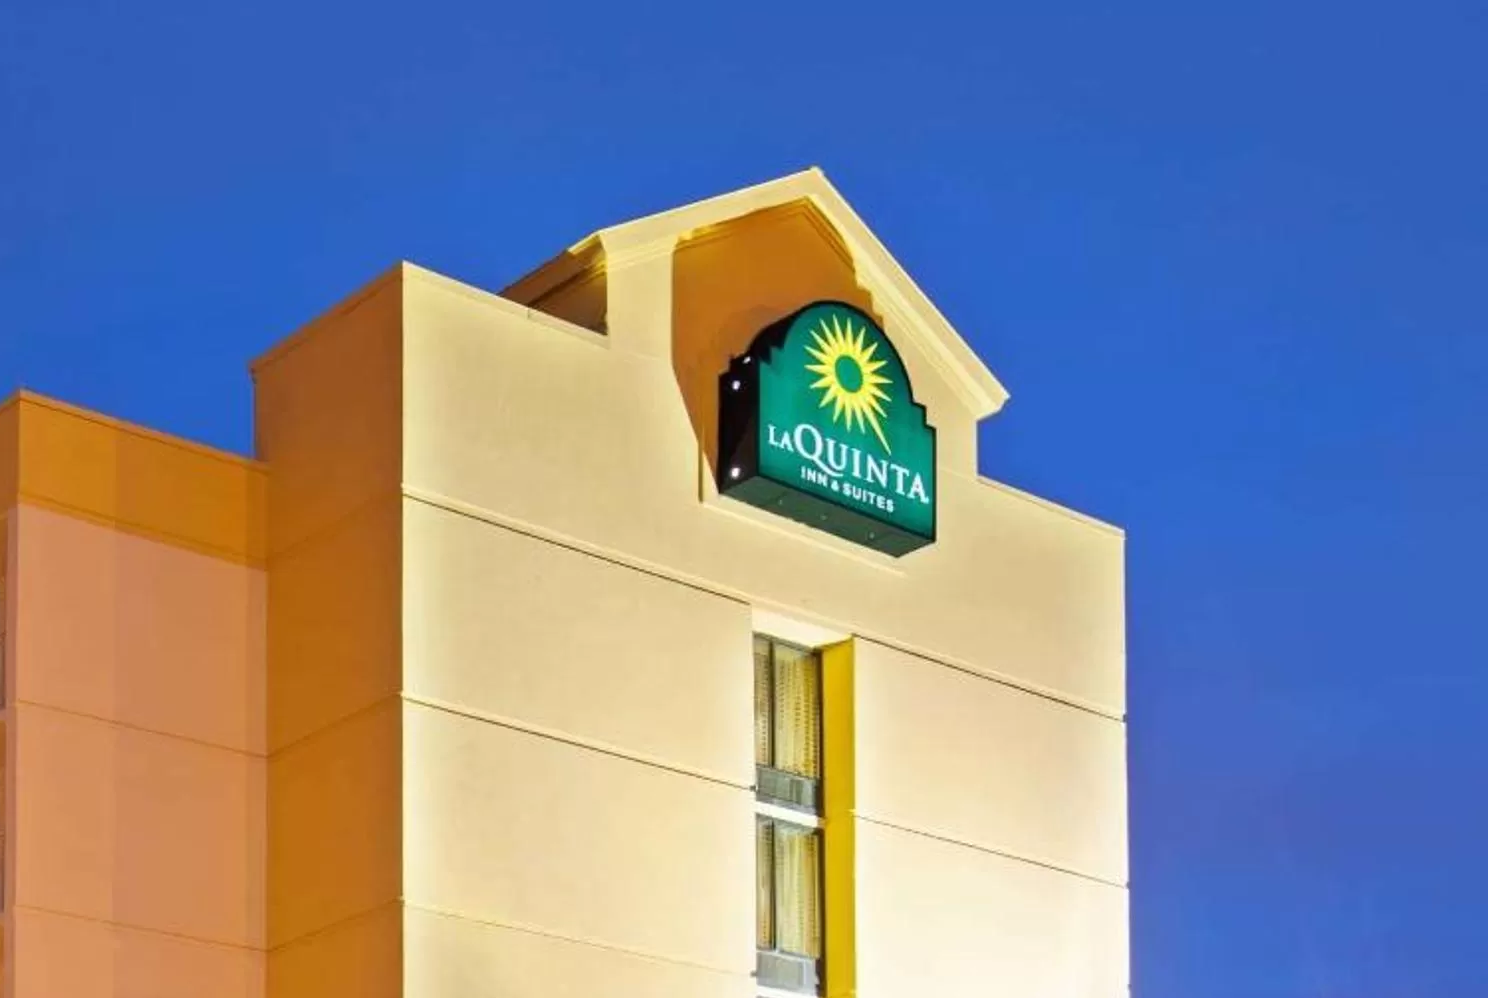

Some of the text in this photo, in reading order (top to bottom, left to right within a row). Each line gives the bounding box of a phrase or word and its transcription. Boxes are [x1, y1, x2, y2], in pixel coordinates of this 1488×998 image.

[768, 424, 930, 504] LA QUINTA
[800, 465, 895, 513] INN & SUITES
